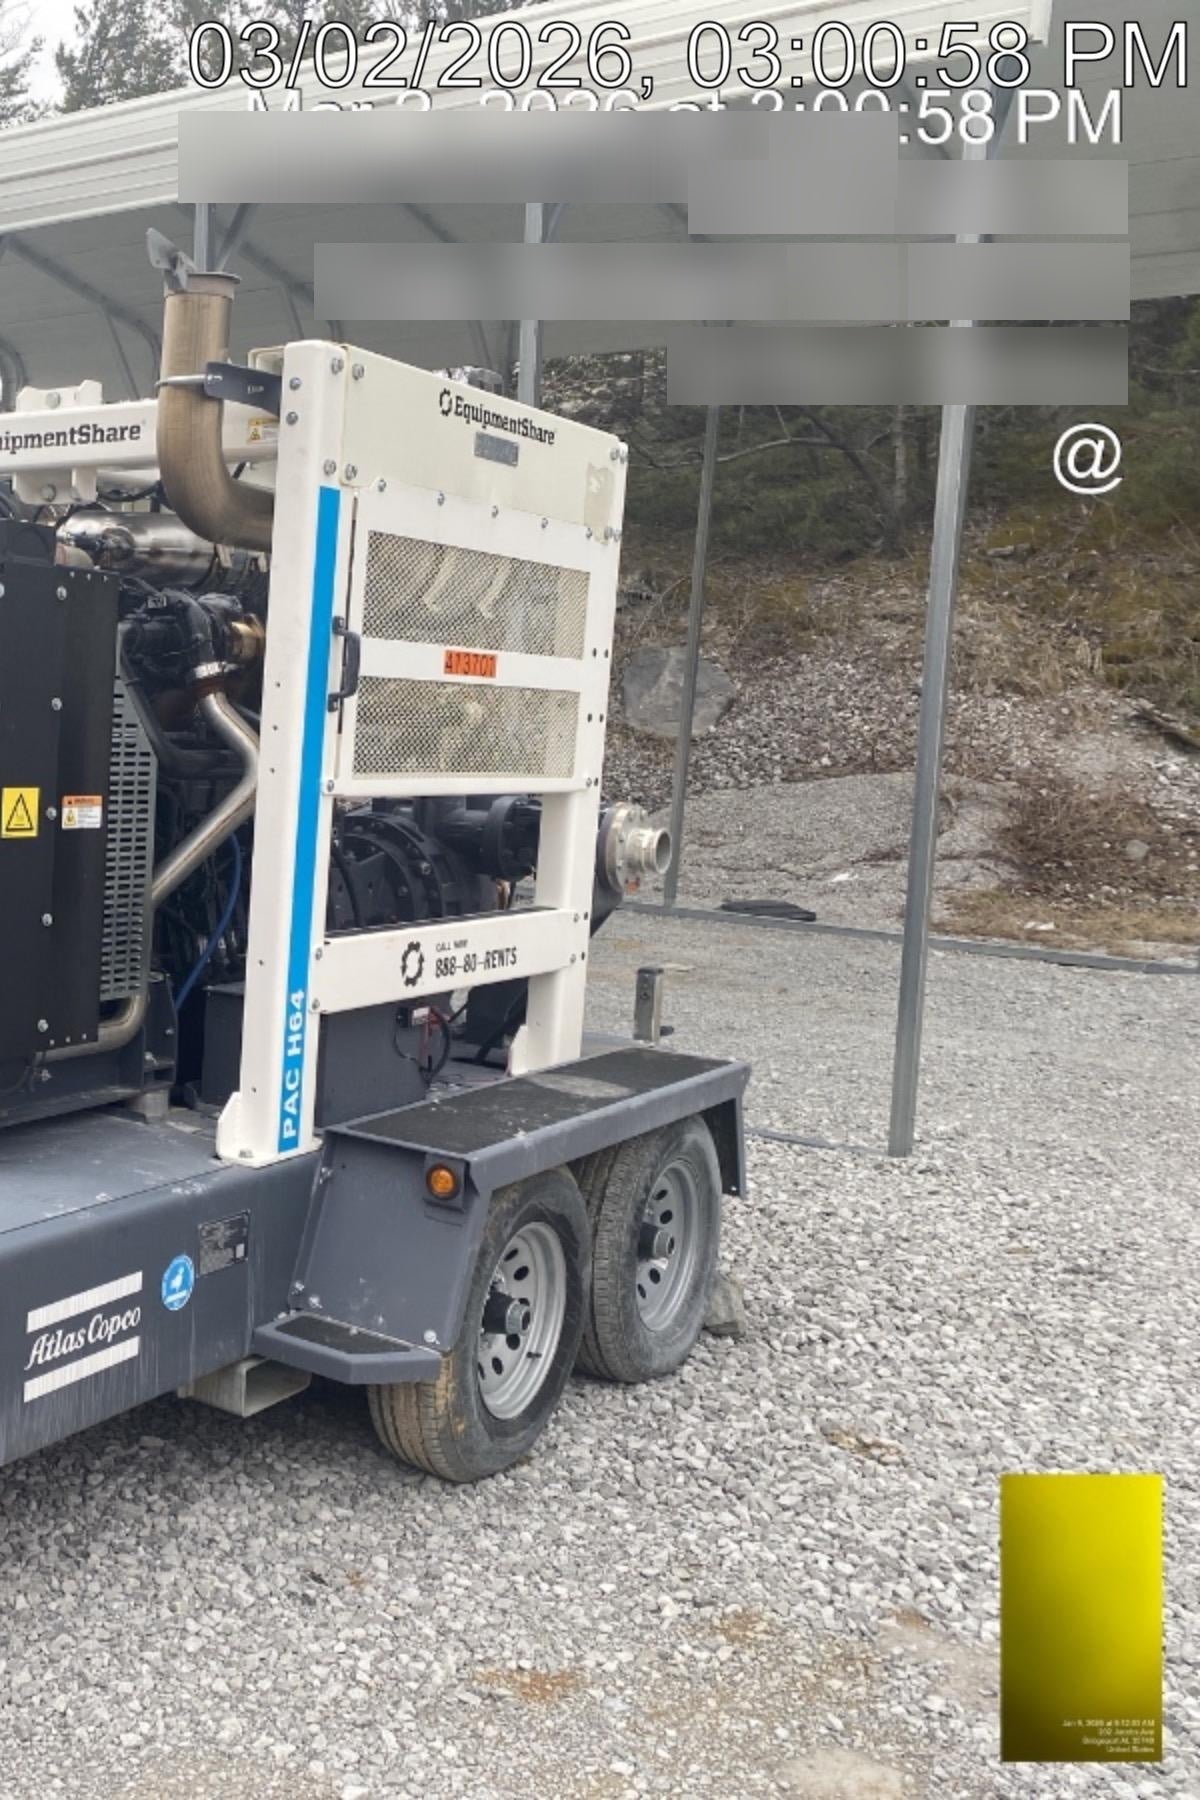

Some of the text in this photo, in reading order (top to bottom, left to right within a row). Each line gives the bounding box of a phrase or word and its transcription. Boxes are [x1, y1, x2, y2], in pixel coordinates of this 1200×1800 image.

[454, 395, 556, 445] EquipmentShare
[435, 941, 452, 953] CALL
[435, 946, 518, 979] 888-80-RENTS
[283, 988, 305, 1139] PAC H64
[23, 1306, 141, 1371] Atlas Copco
